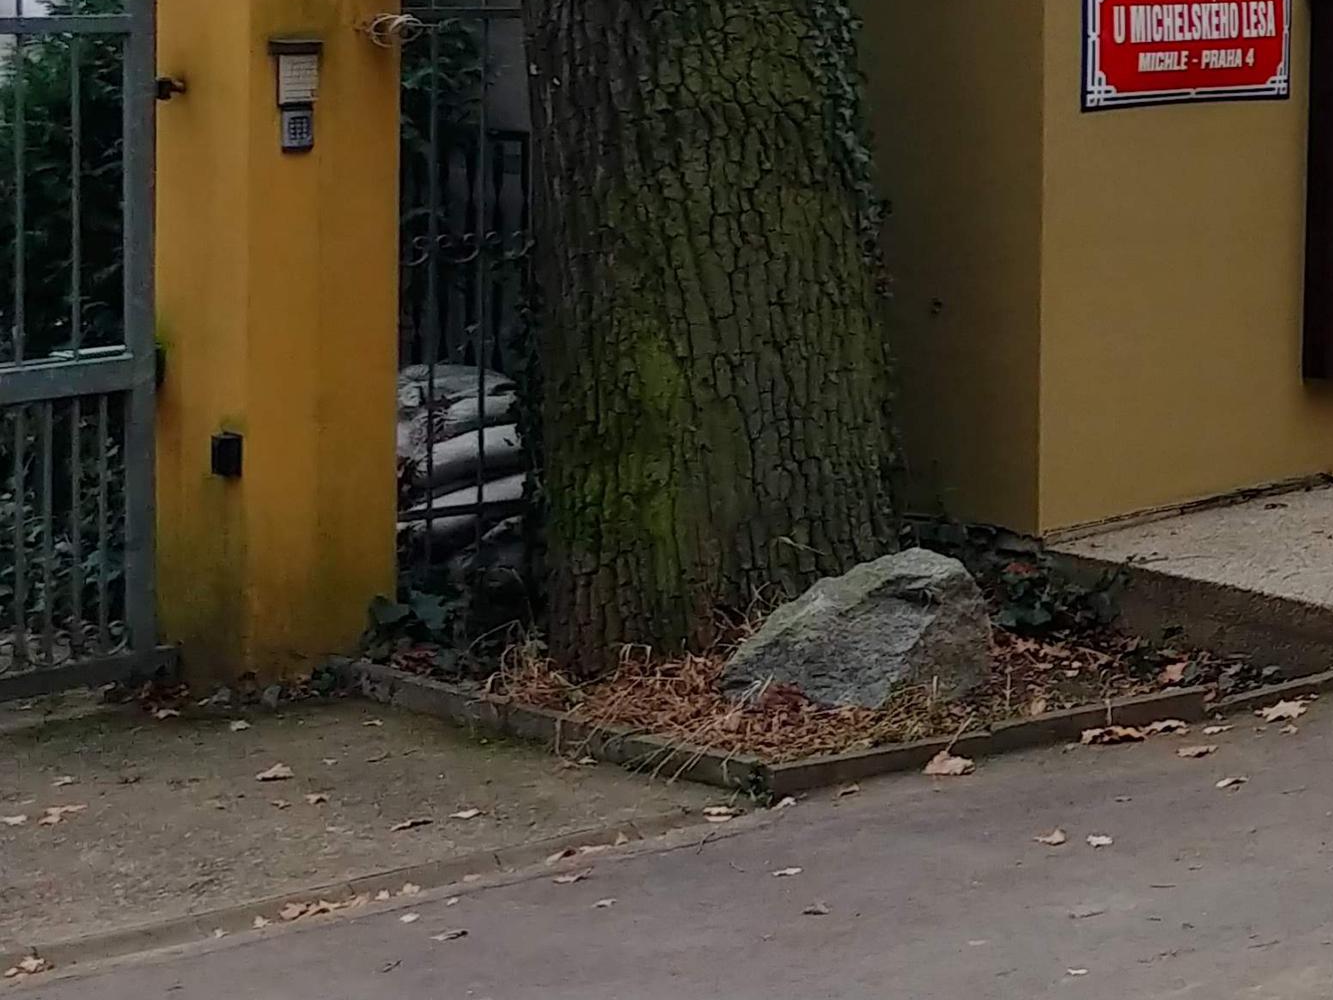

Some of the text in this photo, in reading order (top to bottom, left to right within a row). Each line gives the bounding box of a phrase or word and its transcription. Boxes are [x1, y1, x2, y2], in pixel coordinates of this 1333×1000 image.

[1112, 5, 1126, 44] U
[1242, 0, 1276, 38] LESA
[1138, 50, 1189, 72] MICHLE
[1201, 48, 1242, 69] PRAHA
[1245, 48, 1255, 67] 4
